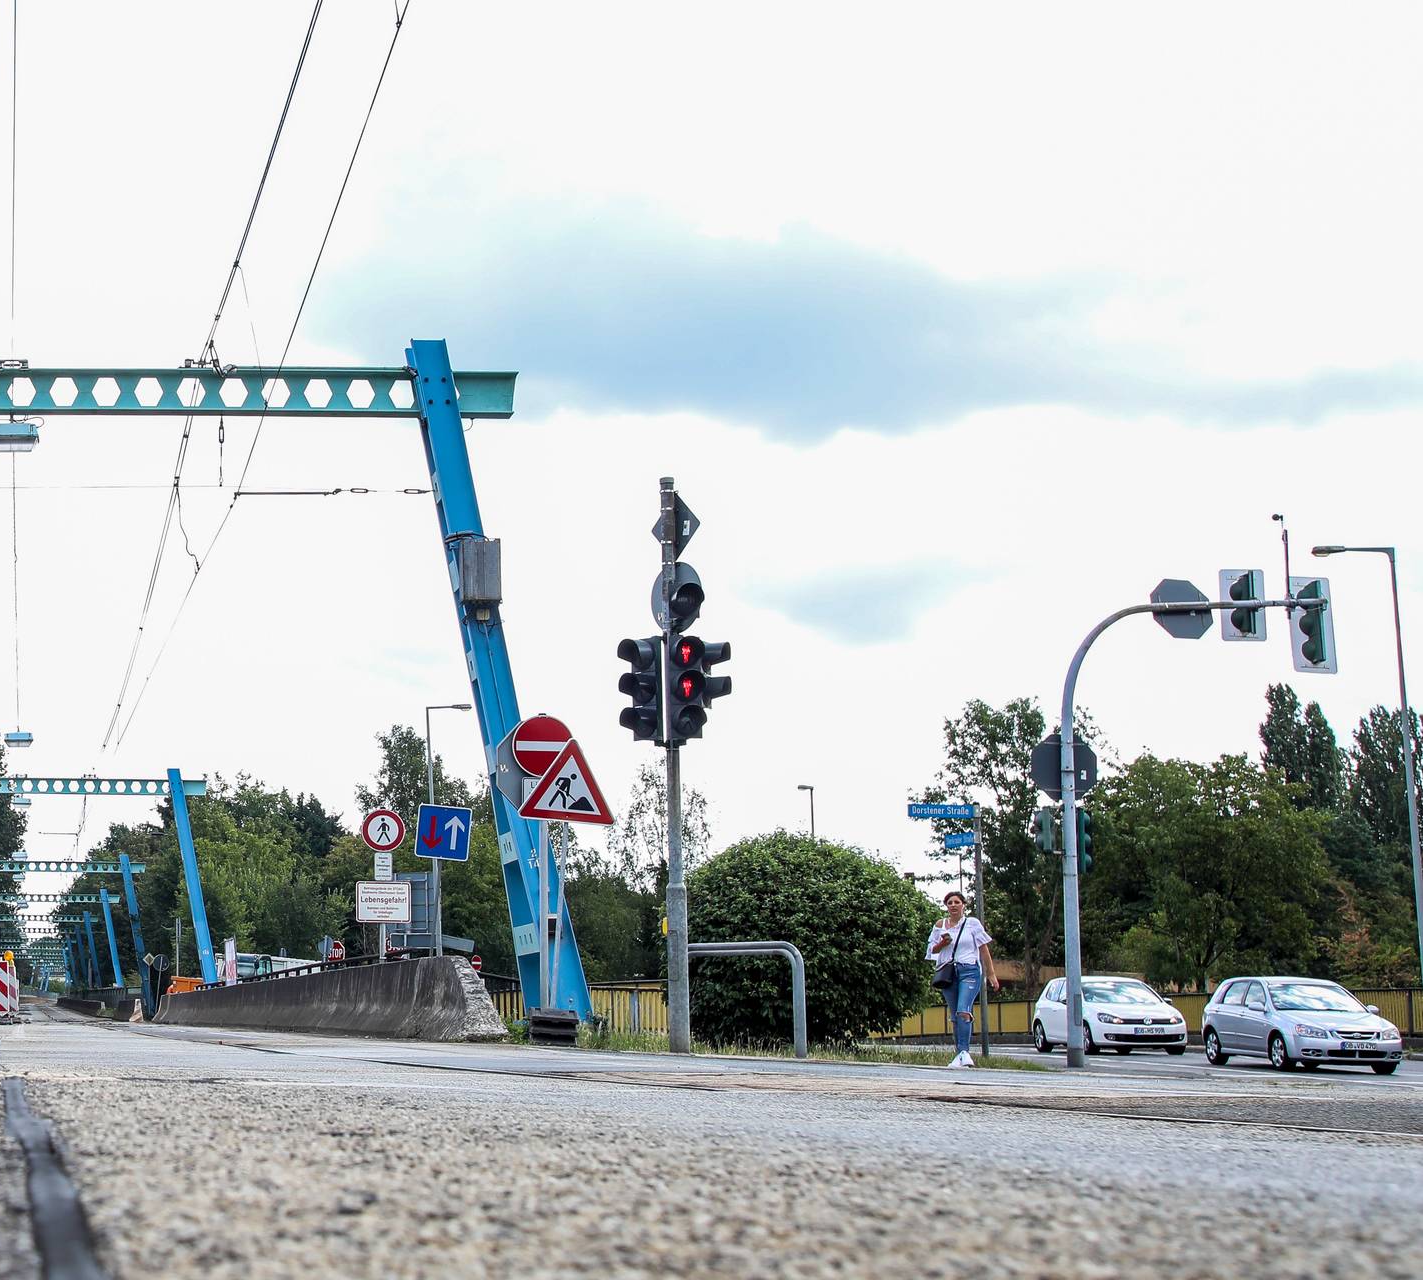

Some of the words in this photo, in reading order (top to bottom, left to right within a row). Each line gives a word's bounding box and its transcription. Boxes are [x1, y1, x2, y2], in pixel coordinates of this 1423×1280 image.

[912, 806, 945, 814] Dorstener
[946, 806, 969, 815] Straße
[360, 896, 407, 904] Lebensgefahr!
[328, 948, 343, 958] STOP
